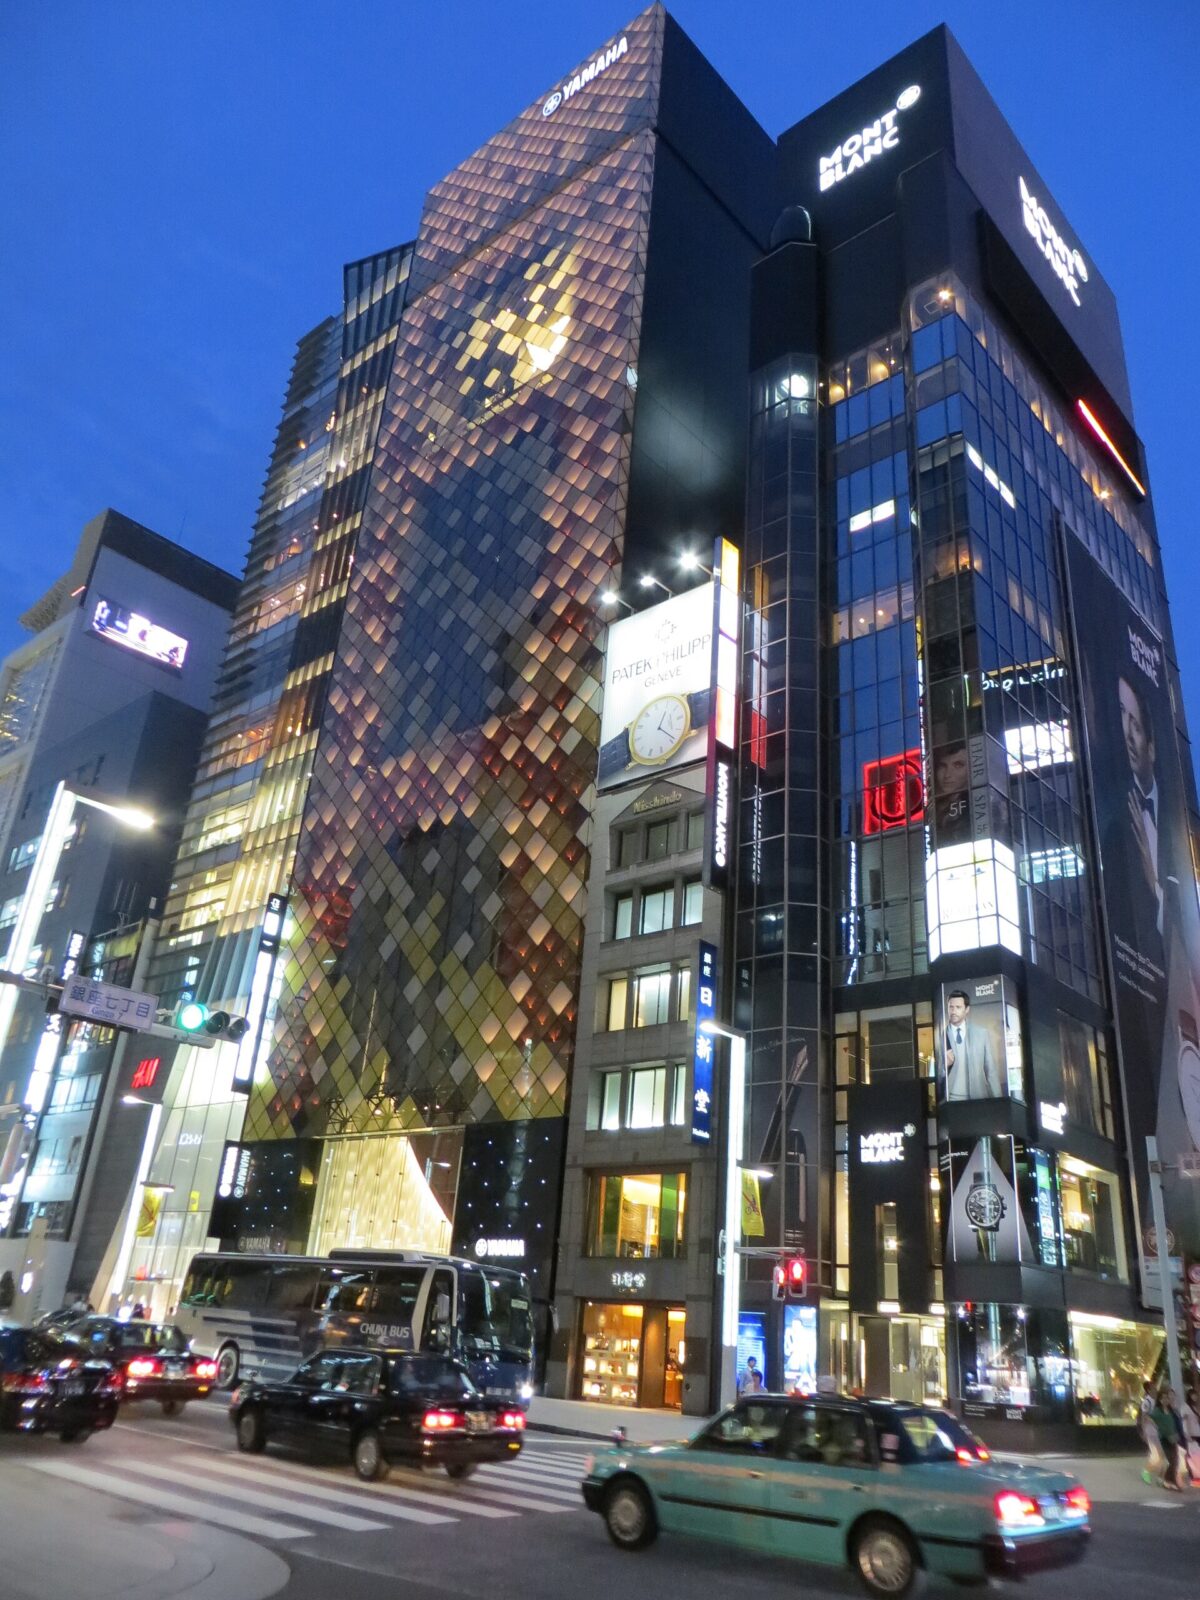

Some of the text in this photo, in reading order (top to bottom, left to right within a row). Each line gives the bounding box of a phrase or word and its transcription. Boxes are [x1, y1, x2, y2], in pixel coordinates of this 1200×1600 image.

[562, 36, 628, 100] YAMAHA
[819, 108, 898, 174] MONT
[819, 126, 900, 192] BLANC
[612, 633, 712, 684] PATEK PHILIPP
[948, 800, 967, 817] 5F
[975, 983, 995, 991] MONT
[975, 988, 995, 997] BLANC
[70, 985, 151, 1018] 銀座七丁目
[860, 1131, 904, 1148] MONT
[860, 1145, 905, 1162] BLANC
[389, 1325, 411, 1338] BUS
